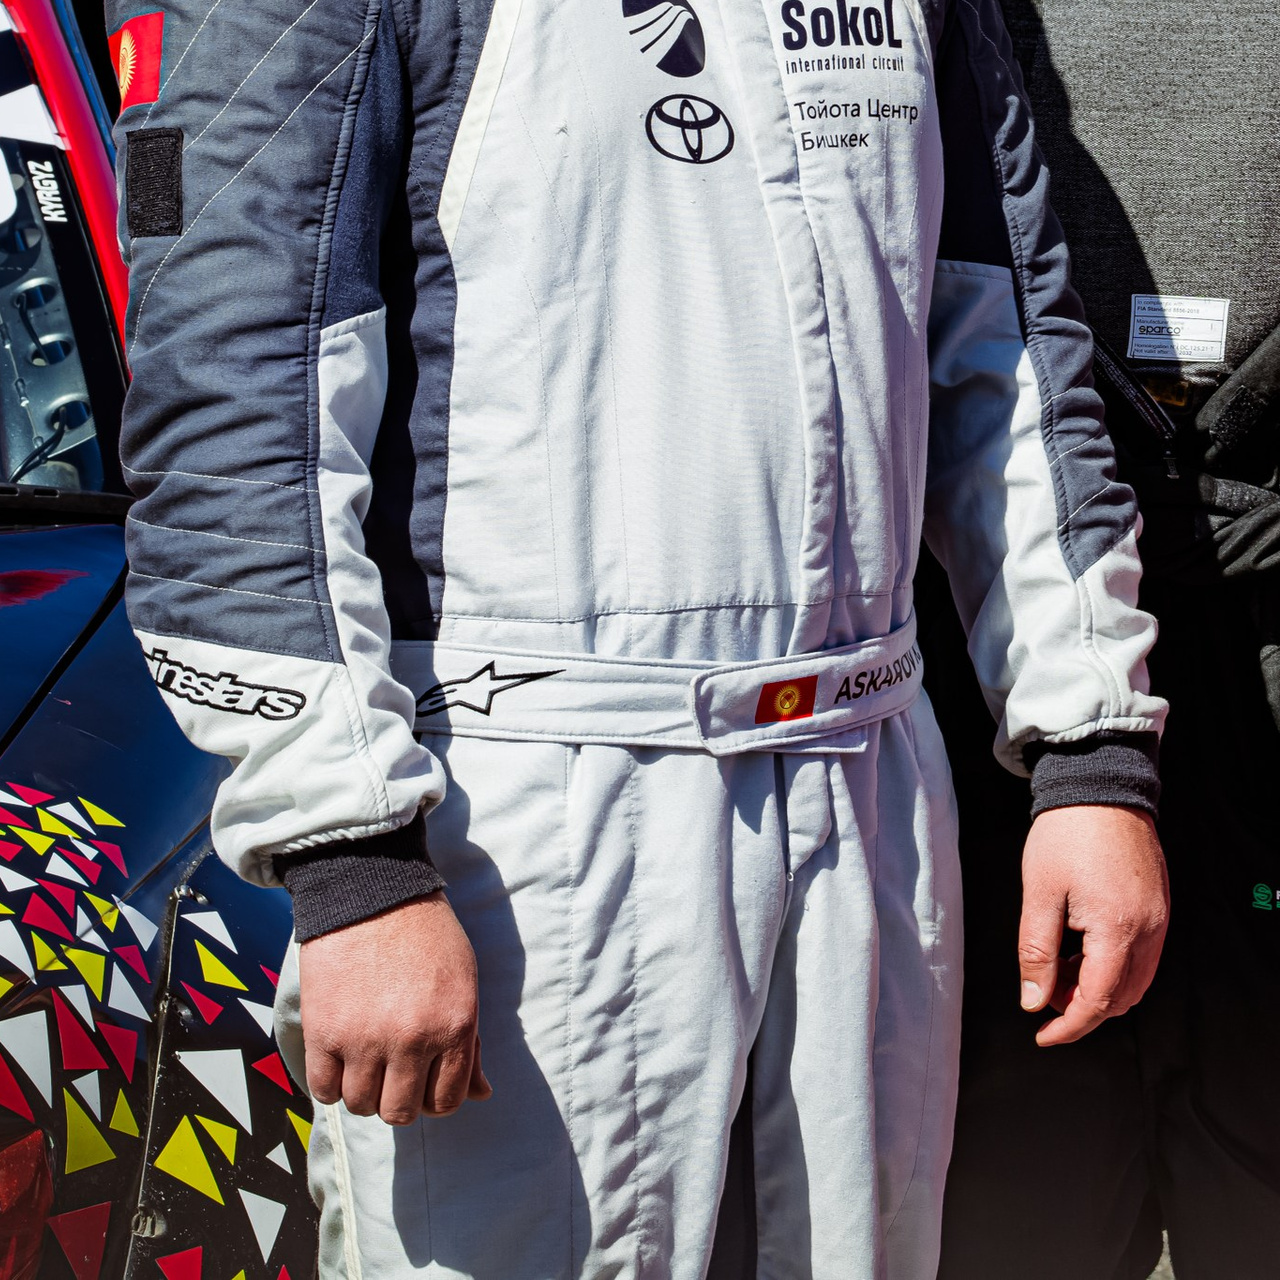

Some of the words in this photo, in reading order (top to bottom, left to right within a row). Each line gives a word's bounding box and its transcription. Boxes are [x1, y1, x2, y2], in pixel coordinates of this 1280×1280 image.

[785, 54, 865, 74] international
[872, 56, 904, 72] circuit
[794, 99, 861, 121] Тойота
[867, 98, 919, 125] Центр
[801, 131, 870, 151] Бишкек
[27, 160, 68, 223] KYRGYZ
[1138, 325, 1181, 336] sparco
[143, 648, 307, 721] inestars
